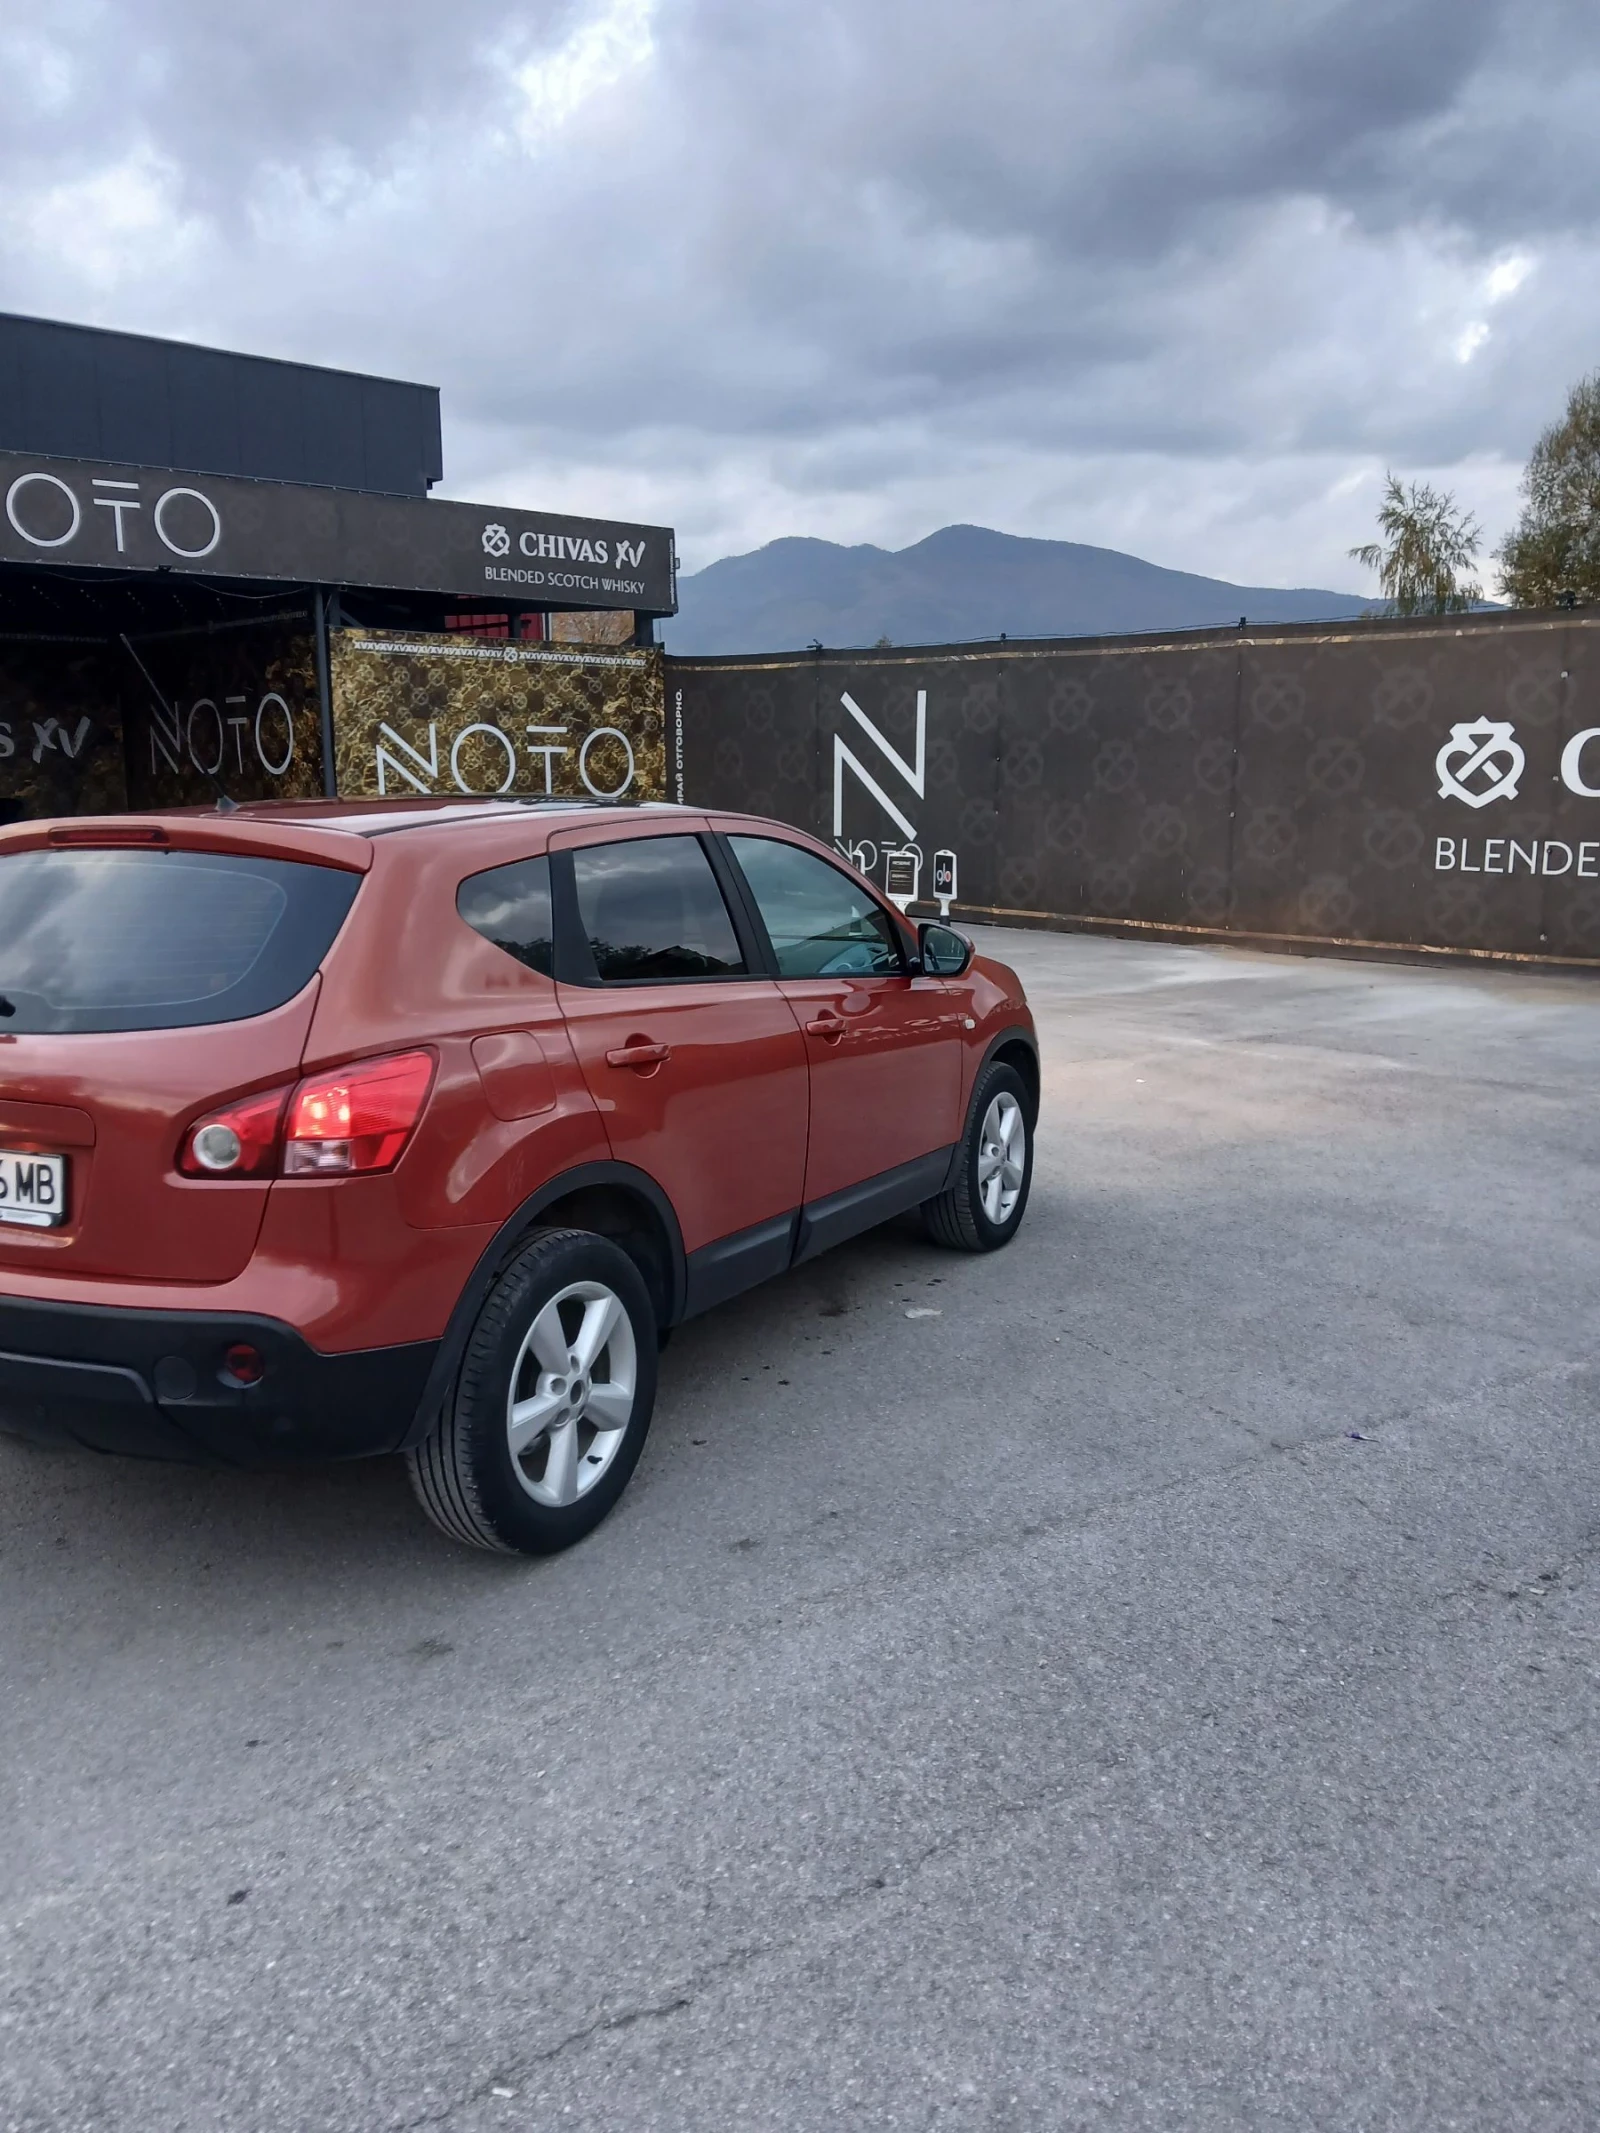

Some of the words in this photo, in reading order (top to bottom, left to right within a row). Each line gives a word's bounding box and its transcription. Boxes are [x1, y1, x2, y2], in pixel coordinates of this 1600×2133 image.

[485, 566, 545, 585] BLENDED
[547, 572, 599, 590] SCOTCH
[601, 578, 645, 595] WHISKY
[519, 531, 609, 564] CHIVAS
[615, 540, 646, 570] XV
[32, 715, 92, 765] XV
[150, 692, 294, 775] NOTO
[376, 722, 635, 798] NOTO
[675, 688, 684, 770] ОТГОВОРНО.
[833, 690, 927, 841] N
[15, 1161, 55, 1204] MB
